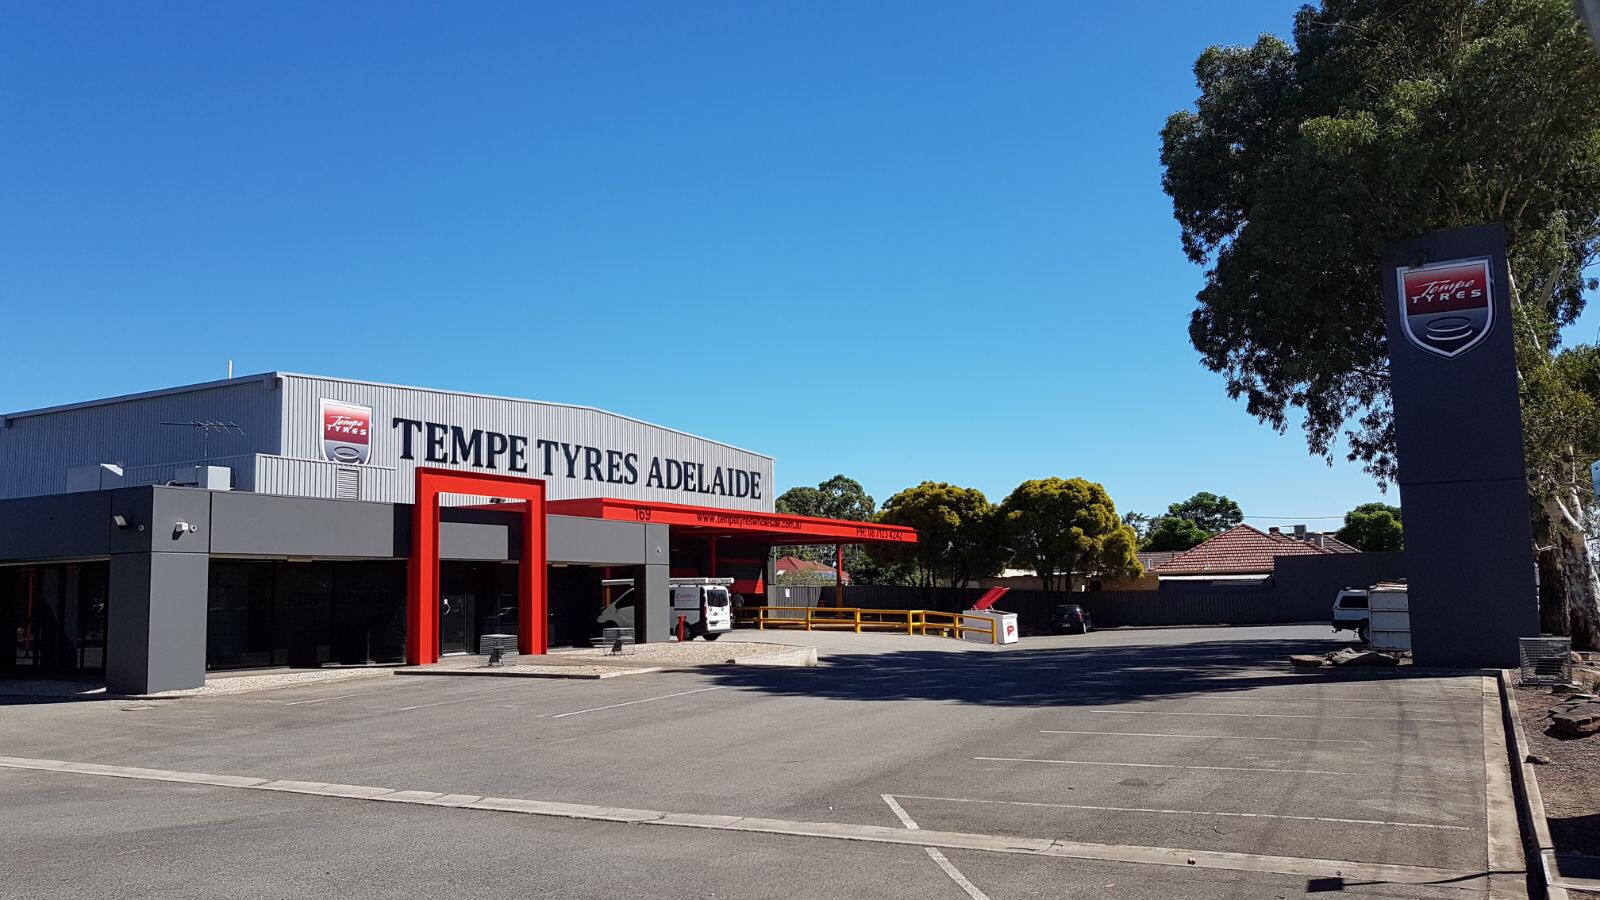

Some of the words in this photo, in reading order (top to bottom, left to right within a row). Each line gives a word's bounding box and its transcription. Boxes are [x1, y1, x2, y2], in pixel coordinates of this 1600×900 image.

[1411, 289, 1482, 304] TYRES
[1416, 280, 1474, 298] Tempe
[326, 424, 367, 436] TYRES
[329, 415, 364, 430] Tempe
[392, 417, 528, 473] TEMPE
[537, 439, 639, 485] TYRES
[645, 456, 761, 500] ADELAIDE
[634, 506, 651, 521] 169
[856, 527, 867, 537] PH:
